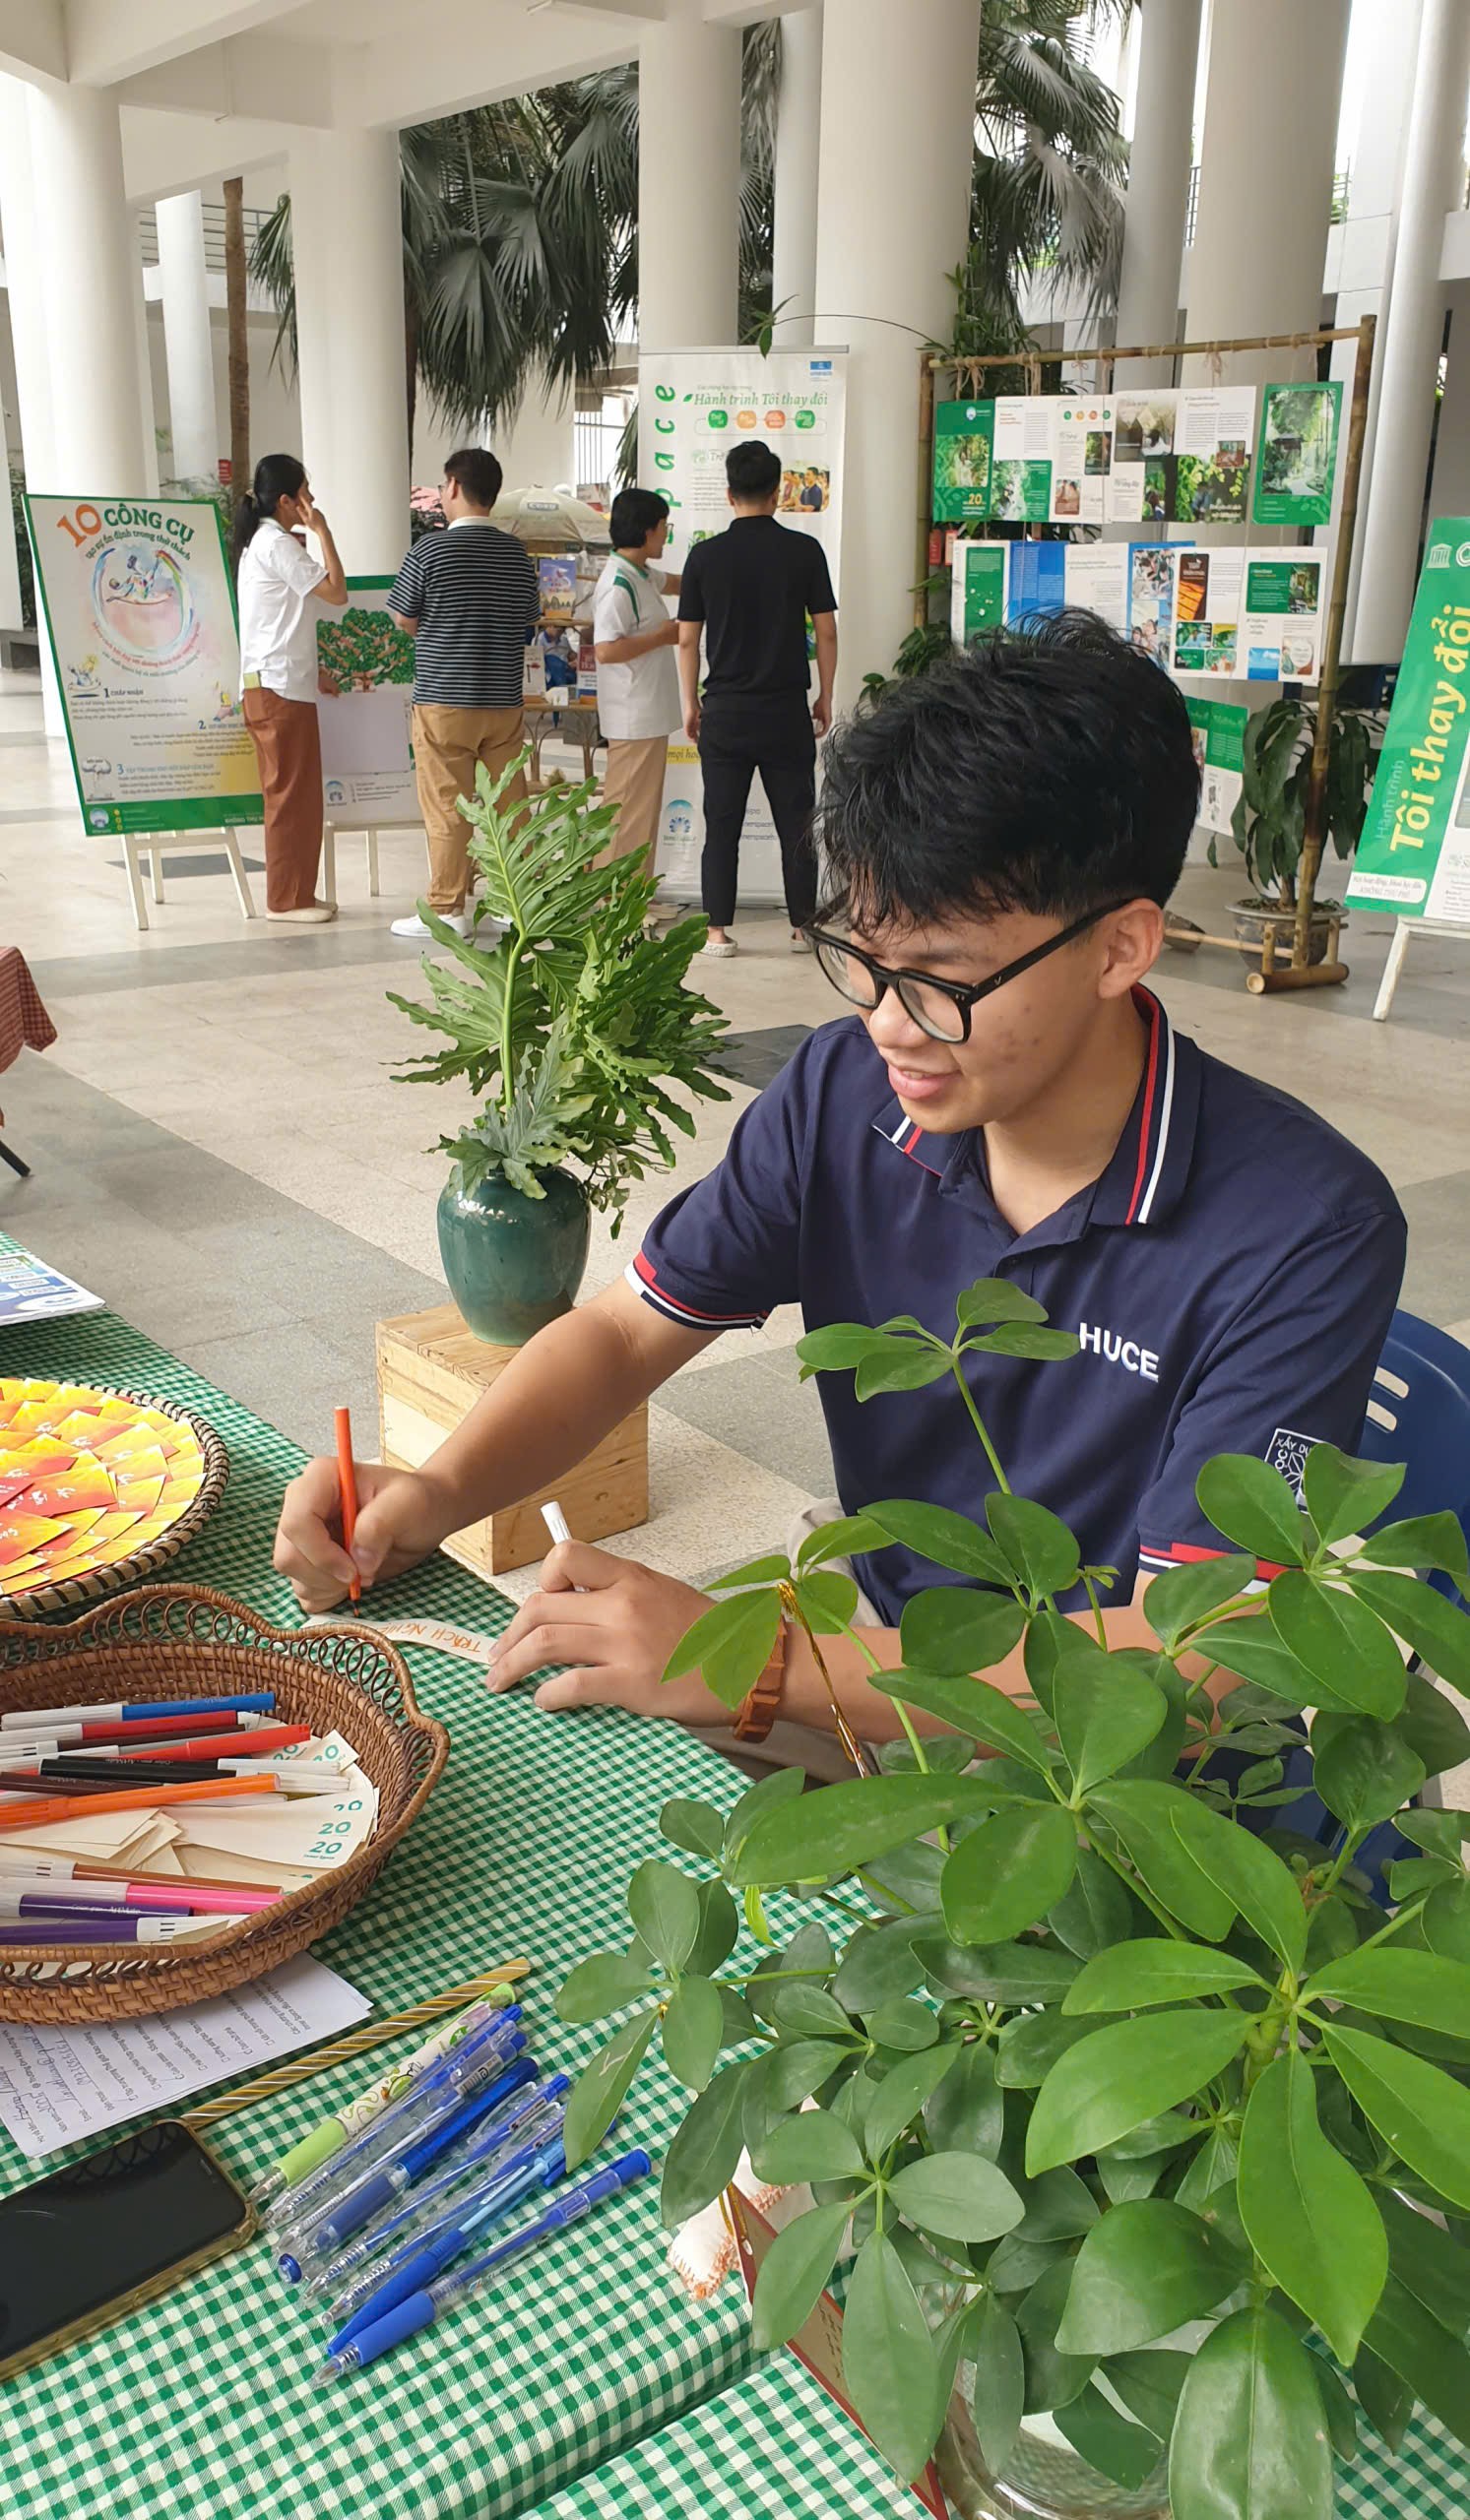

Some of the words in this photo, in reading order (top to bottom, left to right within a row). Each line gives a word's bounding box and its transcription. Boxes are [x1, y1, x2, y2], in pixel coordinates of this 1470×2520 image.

[56, 503, 102, 547] 10
[103, 502, 162, 530] CÔNG
[165, 518, 195, 545] CỤ
[1430, 603, 1470, 674] đổi
[1409, 679, 1467, 784] thay
[1389, 789, 1436, 851] Tôi
[1079, 1322, 1159, 1383] HUCE
[309, 1841, 343, 1855] 20
[318, 1821, 352, 1835] 20
